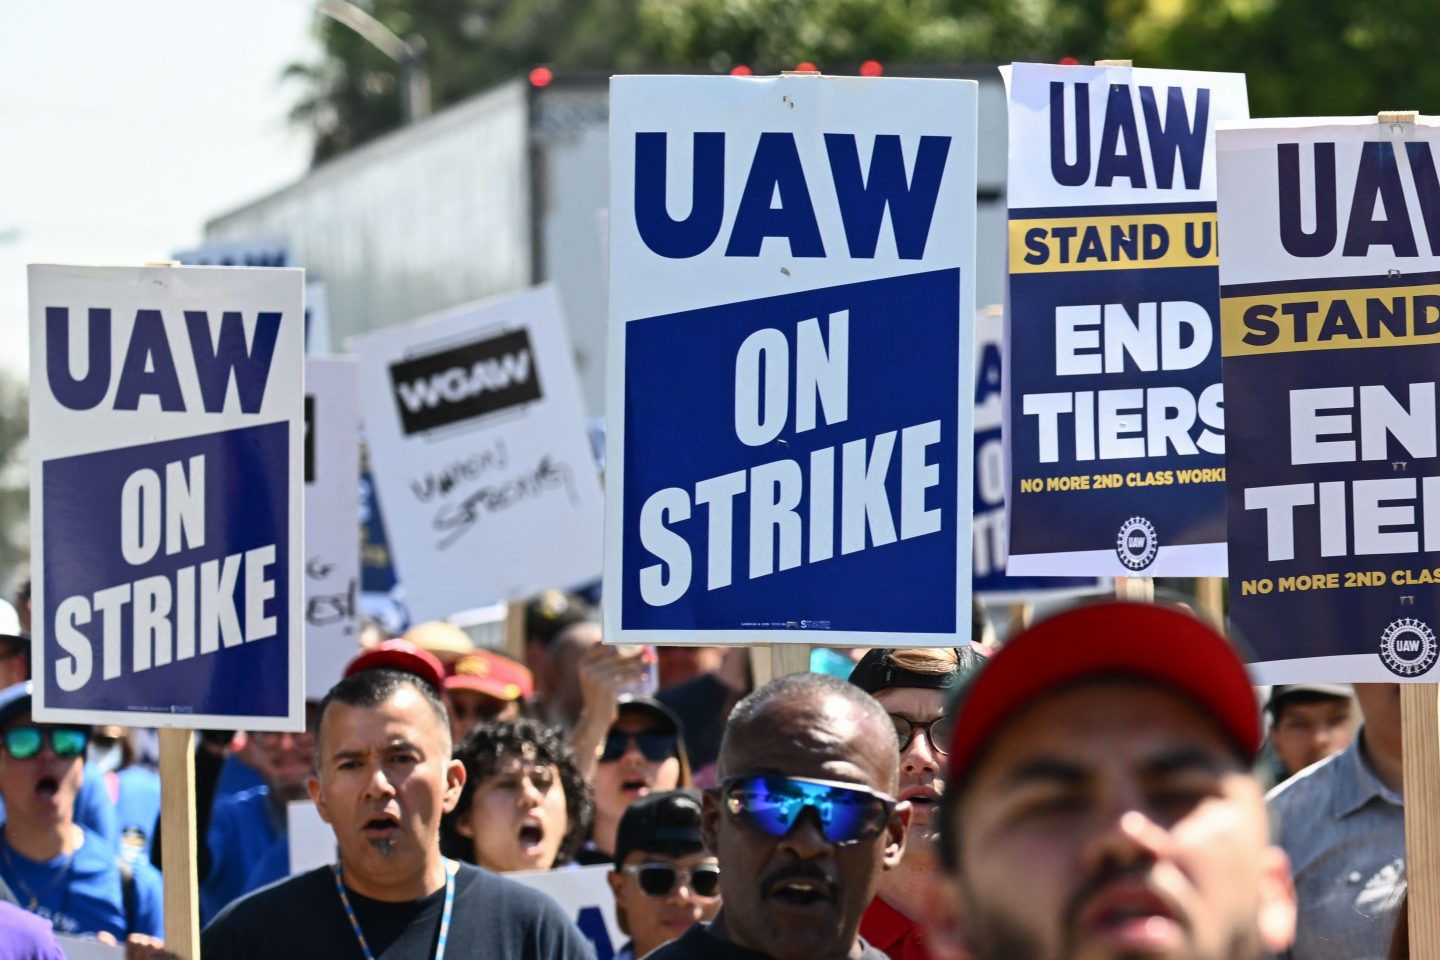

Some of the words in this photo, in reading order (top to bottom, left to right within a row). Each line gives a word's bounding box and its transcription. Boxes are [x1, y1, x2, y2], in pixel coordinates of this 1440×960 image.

[1050, 81, 1210, 190] UAW
[634, 131, 952, 260] UAW
[1024, 223, 1170, 265] STAND
[1185, 221, 1219, 259] U
[45, 306, 283, 414] UAW
[398, 348, 530, 413] WGAW
[735, 309, 849, 446] ON
[1055, 301, 1213, 376] END
[1023, 383, 1226, 463] TIERS
[121, 454, 206, 566] ON
[639, 420, 941, 607] STRIKE
[1020, 478, 1044, 493] NO
[1046, 475, 1090, 492] MORE
[1092, 474, 1123, 489] 2ND
[1126, 471, 1174, 487] CLASS
[1176, 468, 1226, 484] WORK
[54, 544, 278, 693] STRIKE
[1241, 578, 1273, 596] NO
[1278, 573, 1339, 593] MORE
[1343, 570, 1387, 588] 2ND
[1396, 640, 1420, 652] UAW
